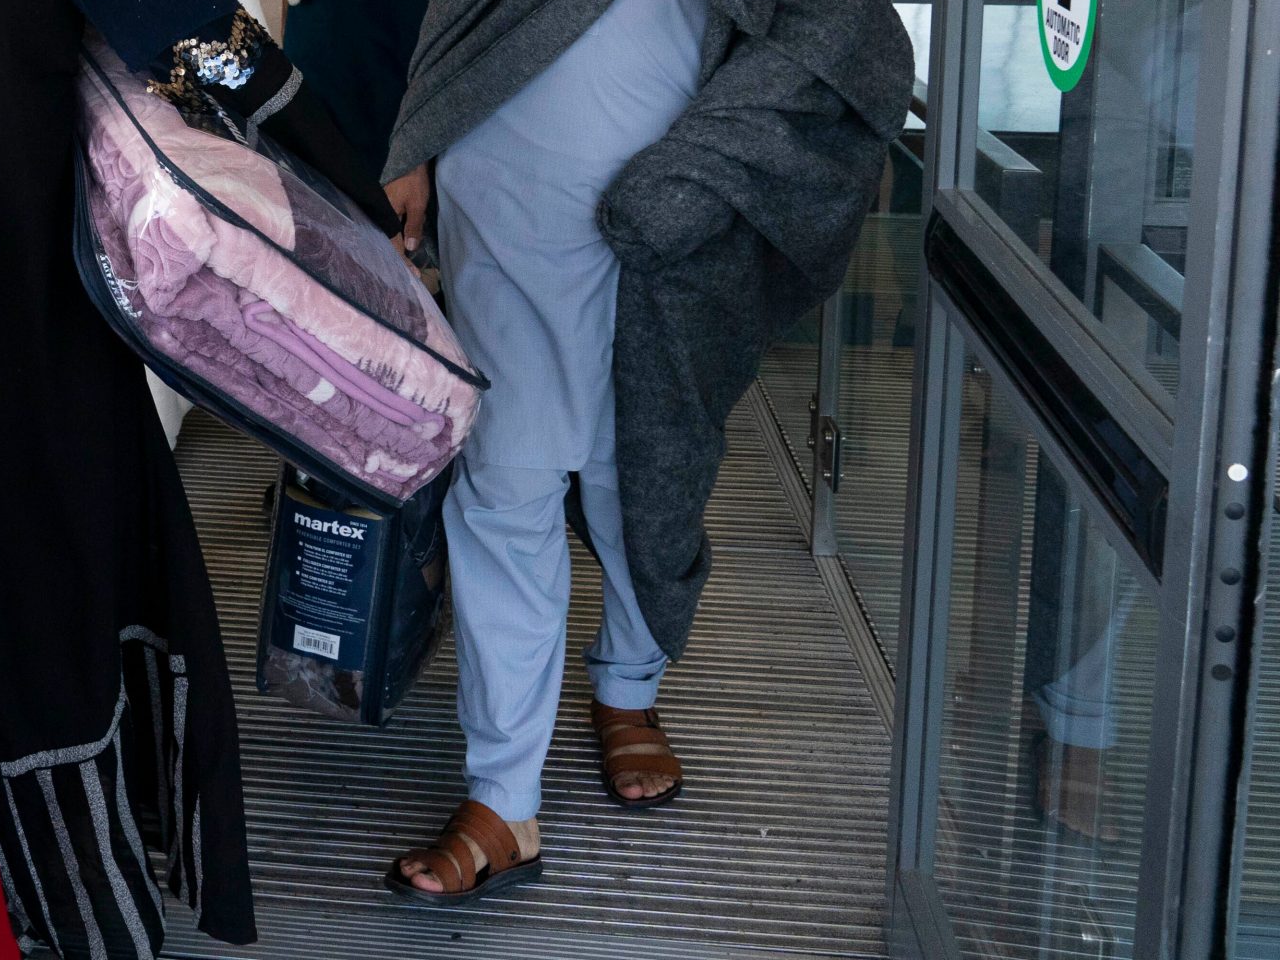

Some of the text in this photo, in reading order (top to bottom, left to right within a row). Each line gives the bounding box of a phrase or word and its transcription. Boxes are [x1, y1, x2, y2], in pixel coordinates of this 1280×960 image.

[1045, 6, 1081, 46] AUTOMATIC
[1053, 35, 1070, 64] DOOR
[294, 512, 365, 541] martex
